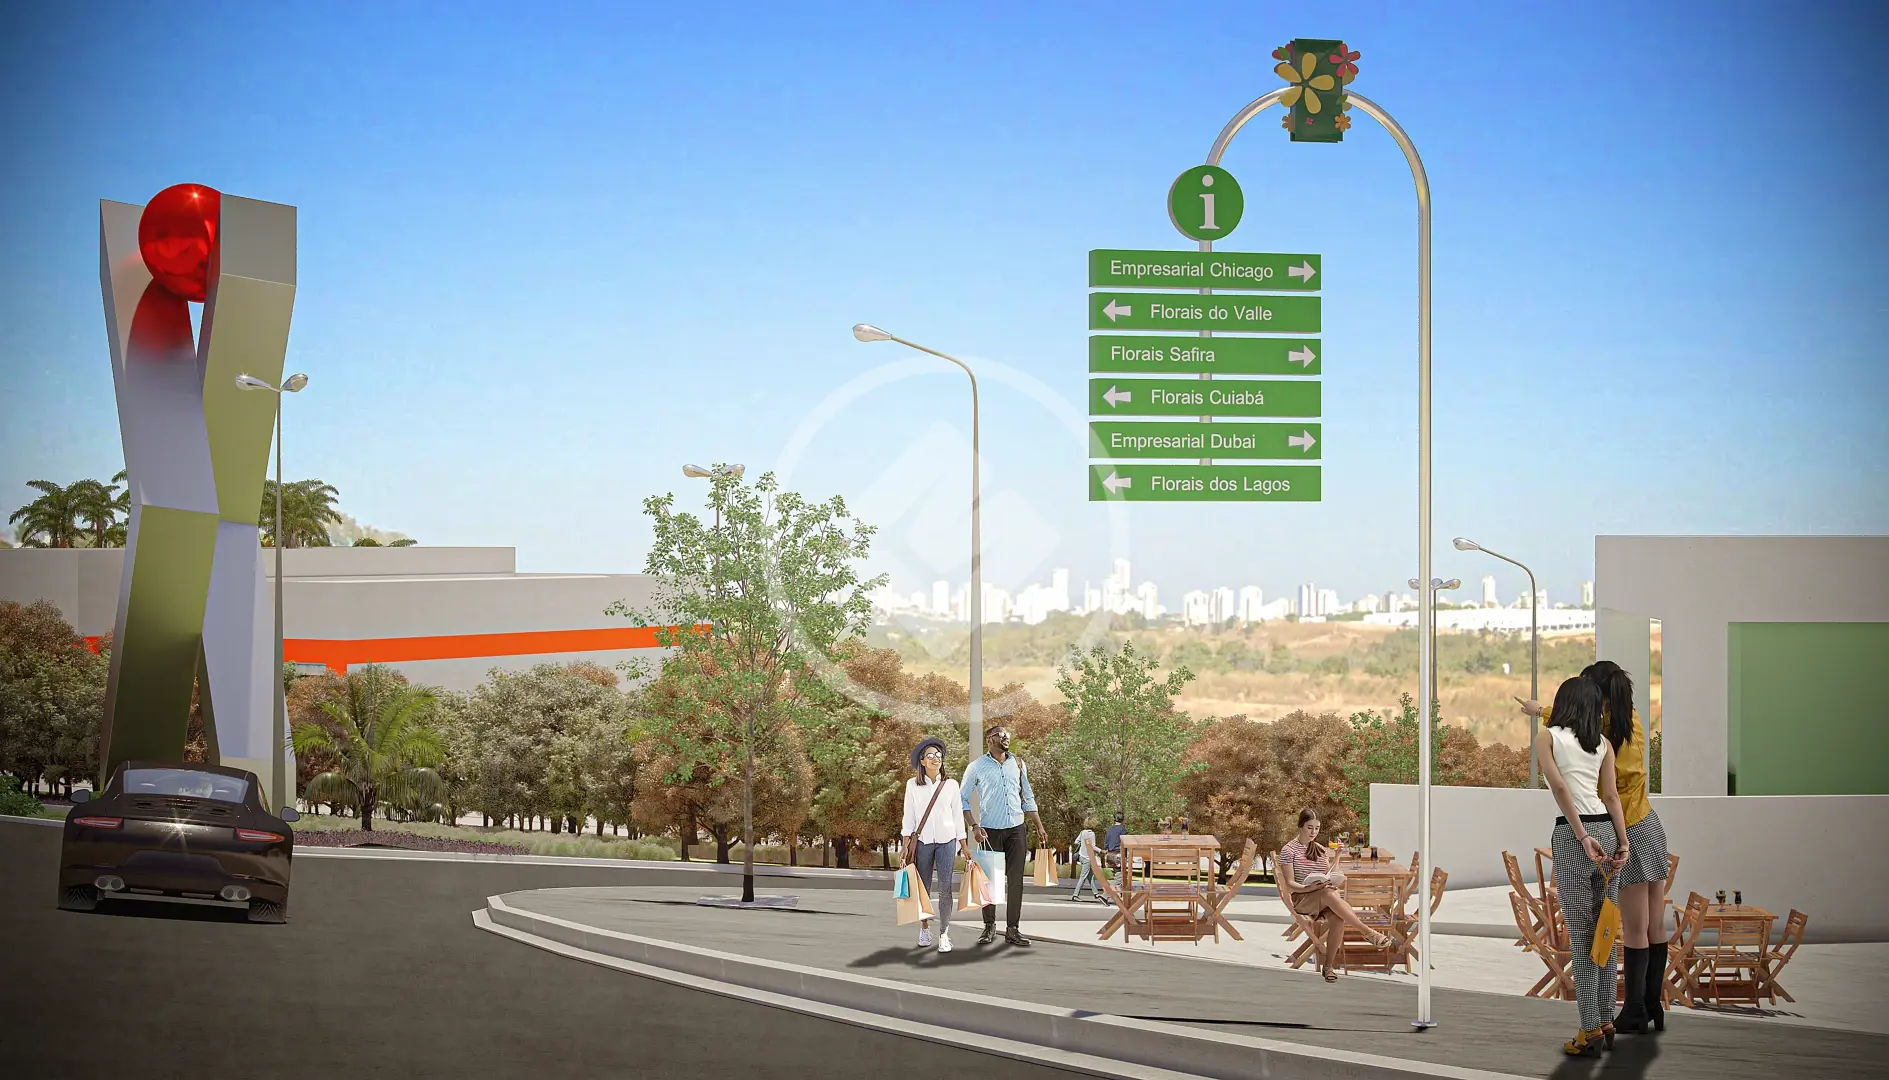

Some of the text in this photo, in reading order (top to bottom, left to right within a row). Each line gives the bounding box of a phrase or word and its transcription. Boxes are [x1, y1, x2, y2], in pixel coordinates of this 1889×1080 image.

[1110, 260, 1274, 281] Empresarial Chicago
[1150, 304, 1272, 321] Florais do Valle
[1111, 346, 1215, 362] Florais Safira
[1151, 389, 1264, 405] Florais Cuiabá
[1111, 433, 1256, 452] Empresarial Dubai
[1151, 476, 1291, 495] Florais dos Lagos
